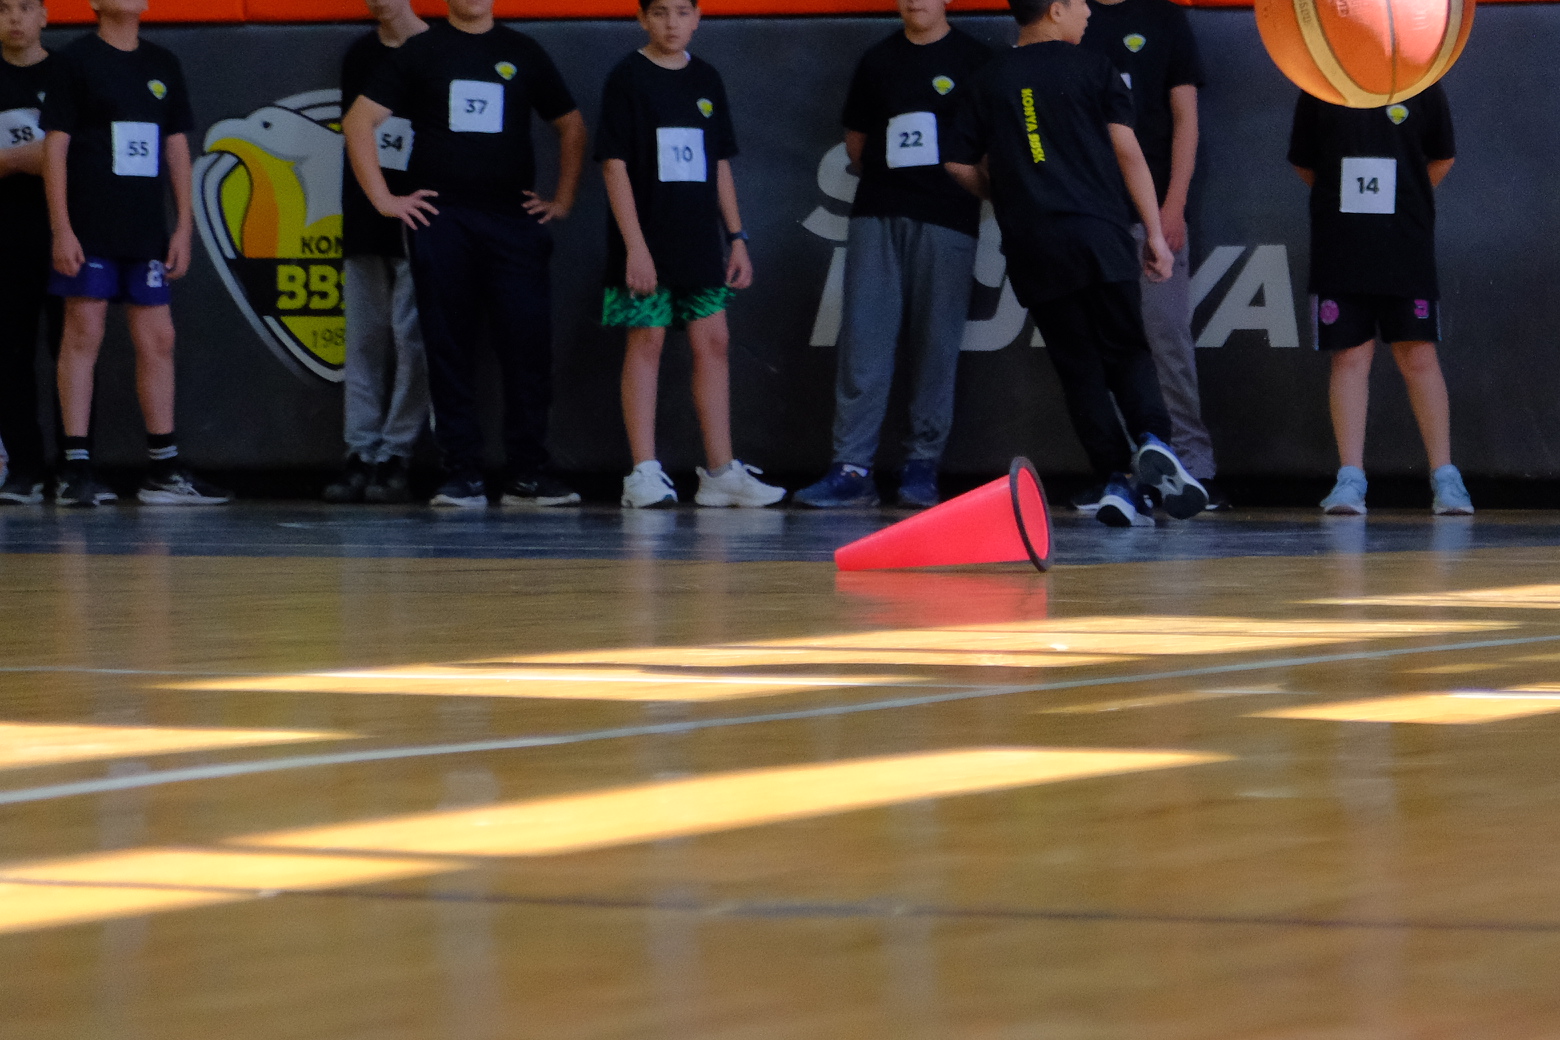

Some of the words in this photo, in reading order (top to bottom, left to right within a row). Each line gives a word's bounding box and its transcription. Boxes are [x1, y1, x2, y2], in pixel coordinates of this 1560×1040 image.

[465, 98, 488, 115] 37
[9, 126, 34, 145] 38
[380, 133, 404, 152] 54
[899, 130, 924, 148] 22
[128, 141, 150, 157] 55
[672, 146, 694, 163] 10
[1356, 176, 1380, 194] 14
